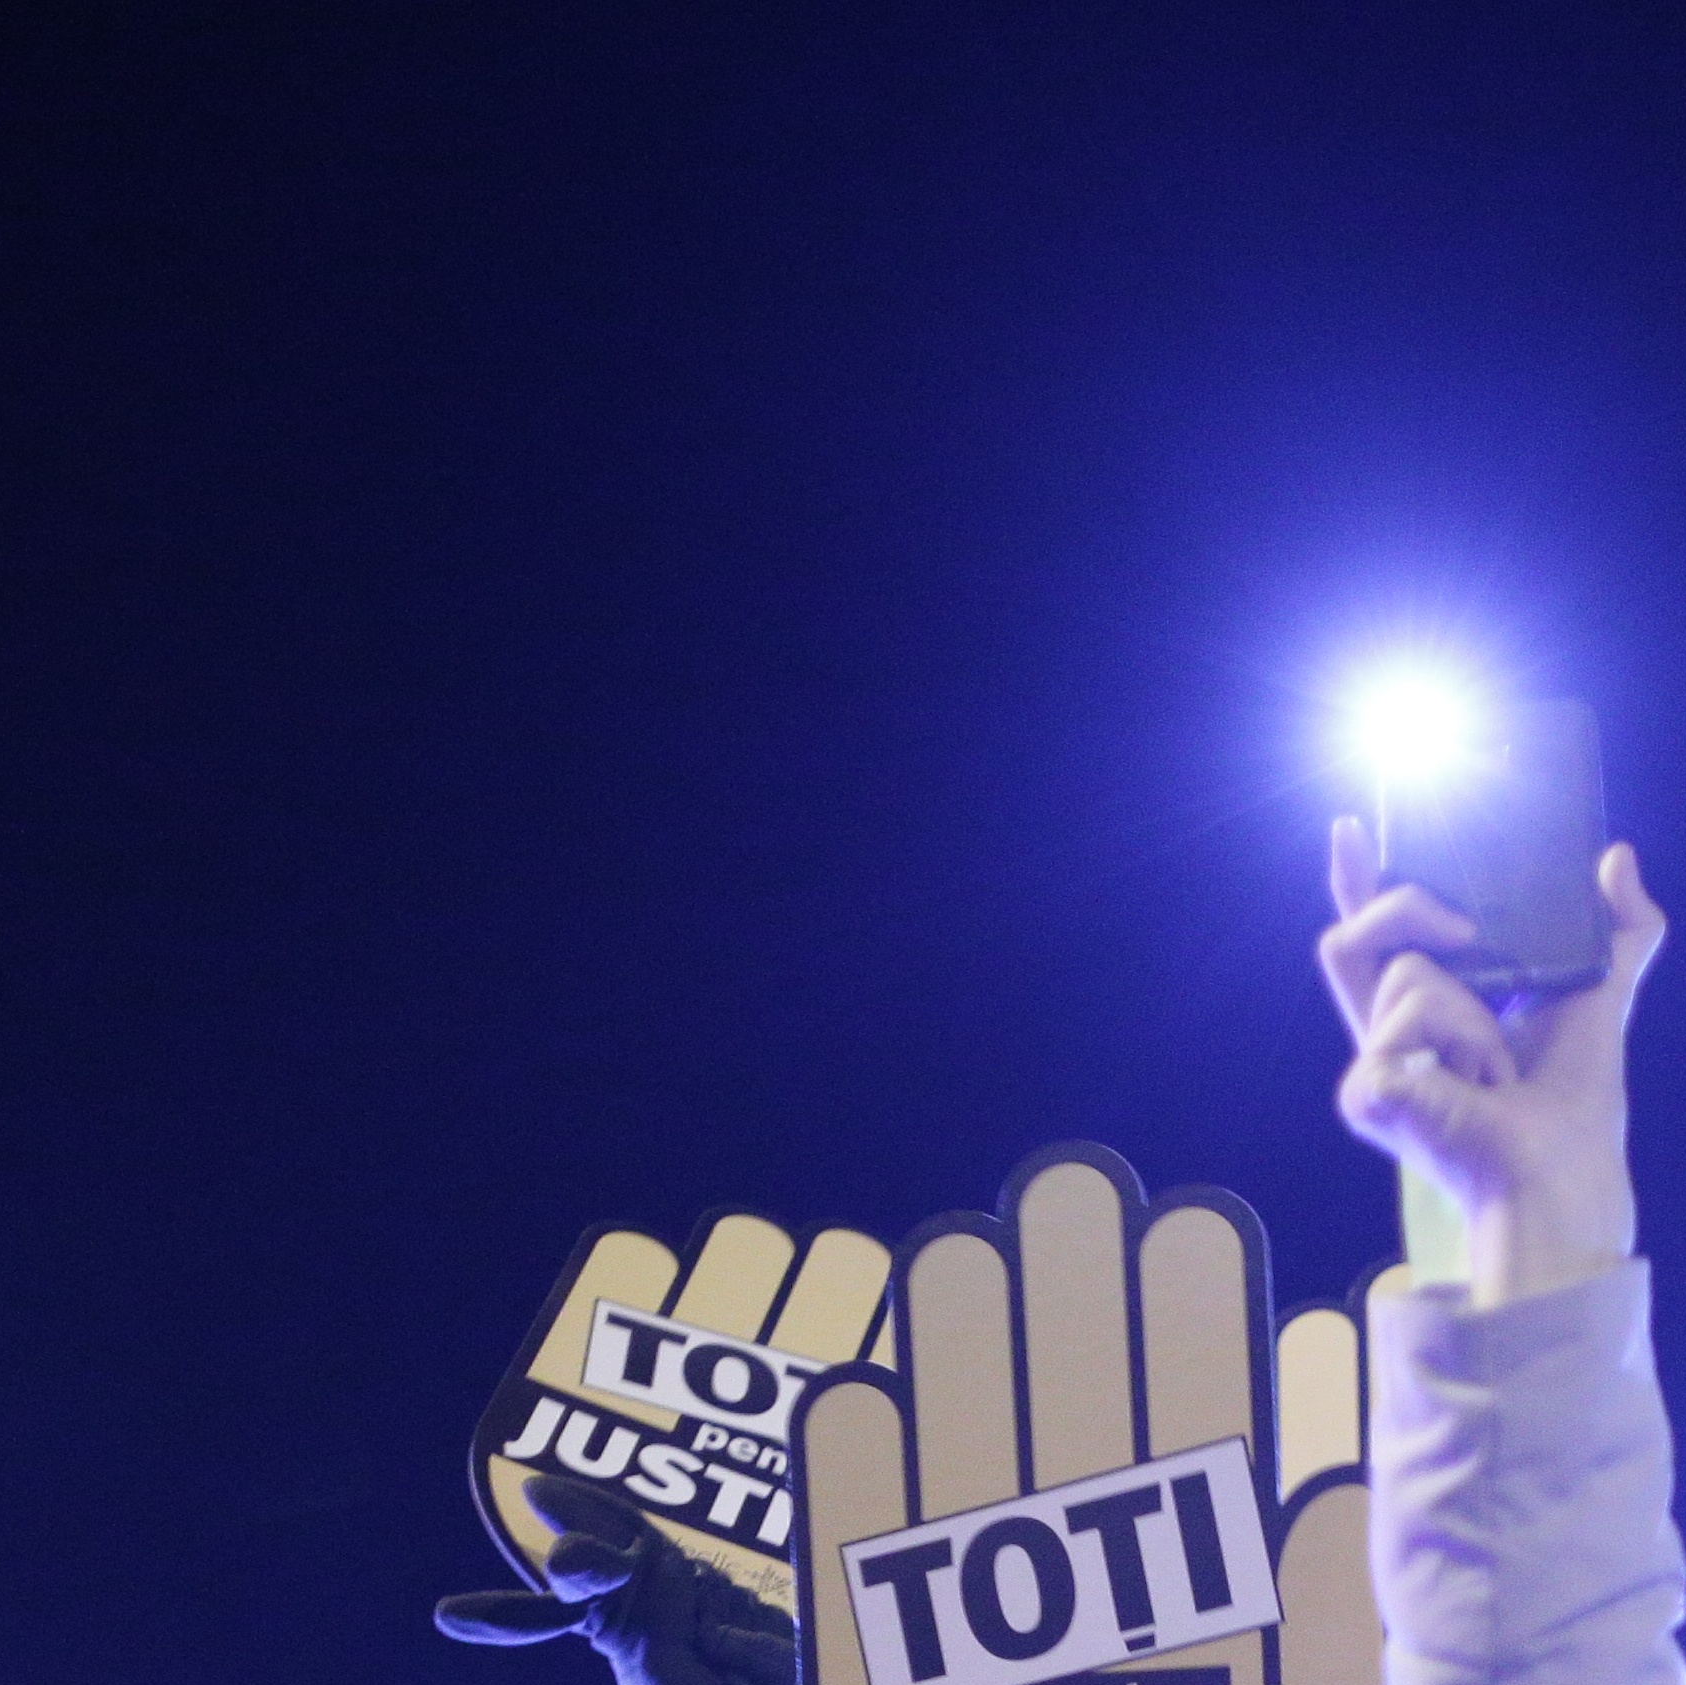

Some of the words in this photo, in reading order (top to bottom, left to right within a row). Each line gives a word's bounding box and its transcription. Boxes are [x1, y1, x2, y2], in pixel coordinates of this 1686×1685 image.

[605, 1312, 823, 1418] TO
[504, 1396, 793, 1547] JUSTI
[691, 1423, 787, 1475] pen
[861, 1472, 1233, 1685] TOȚI
